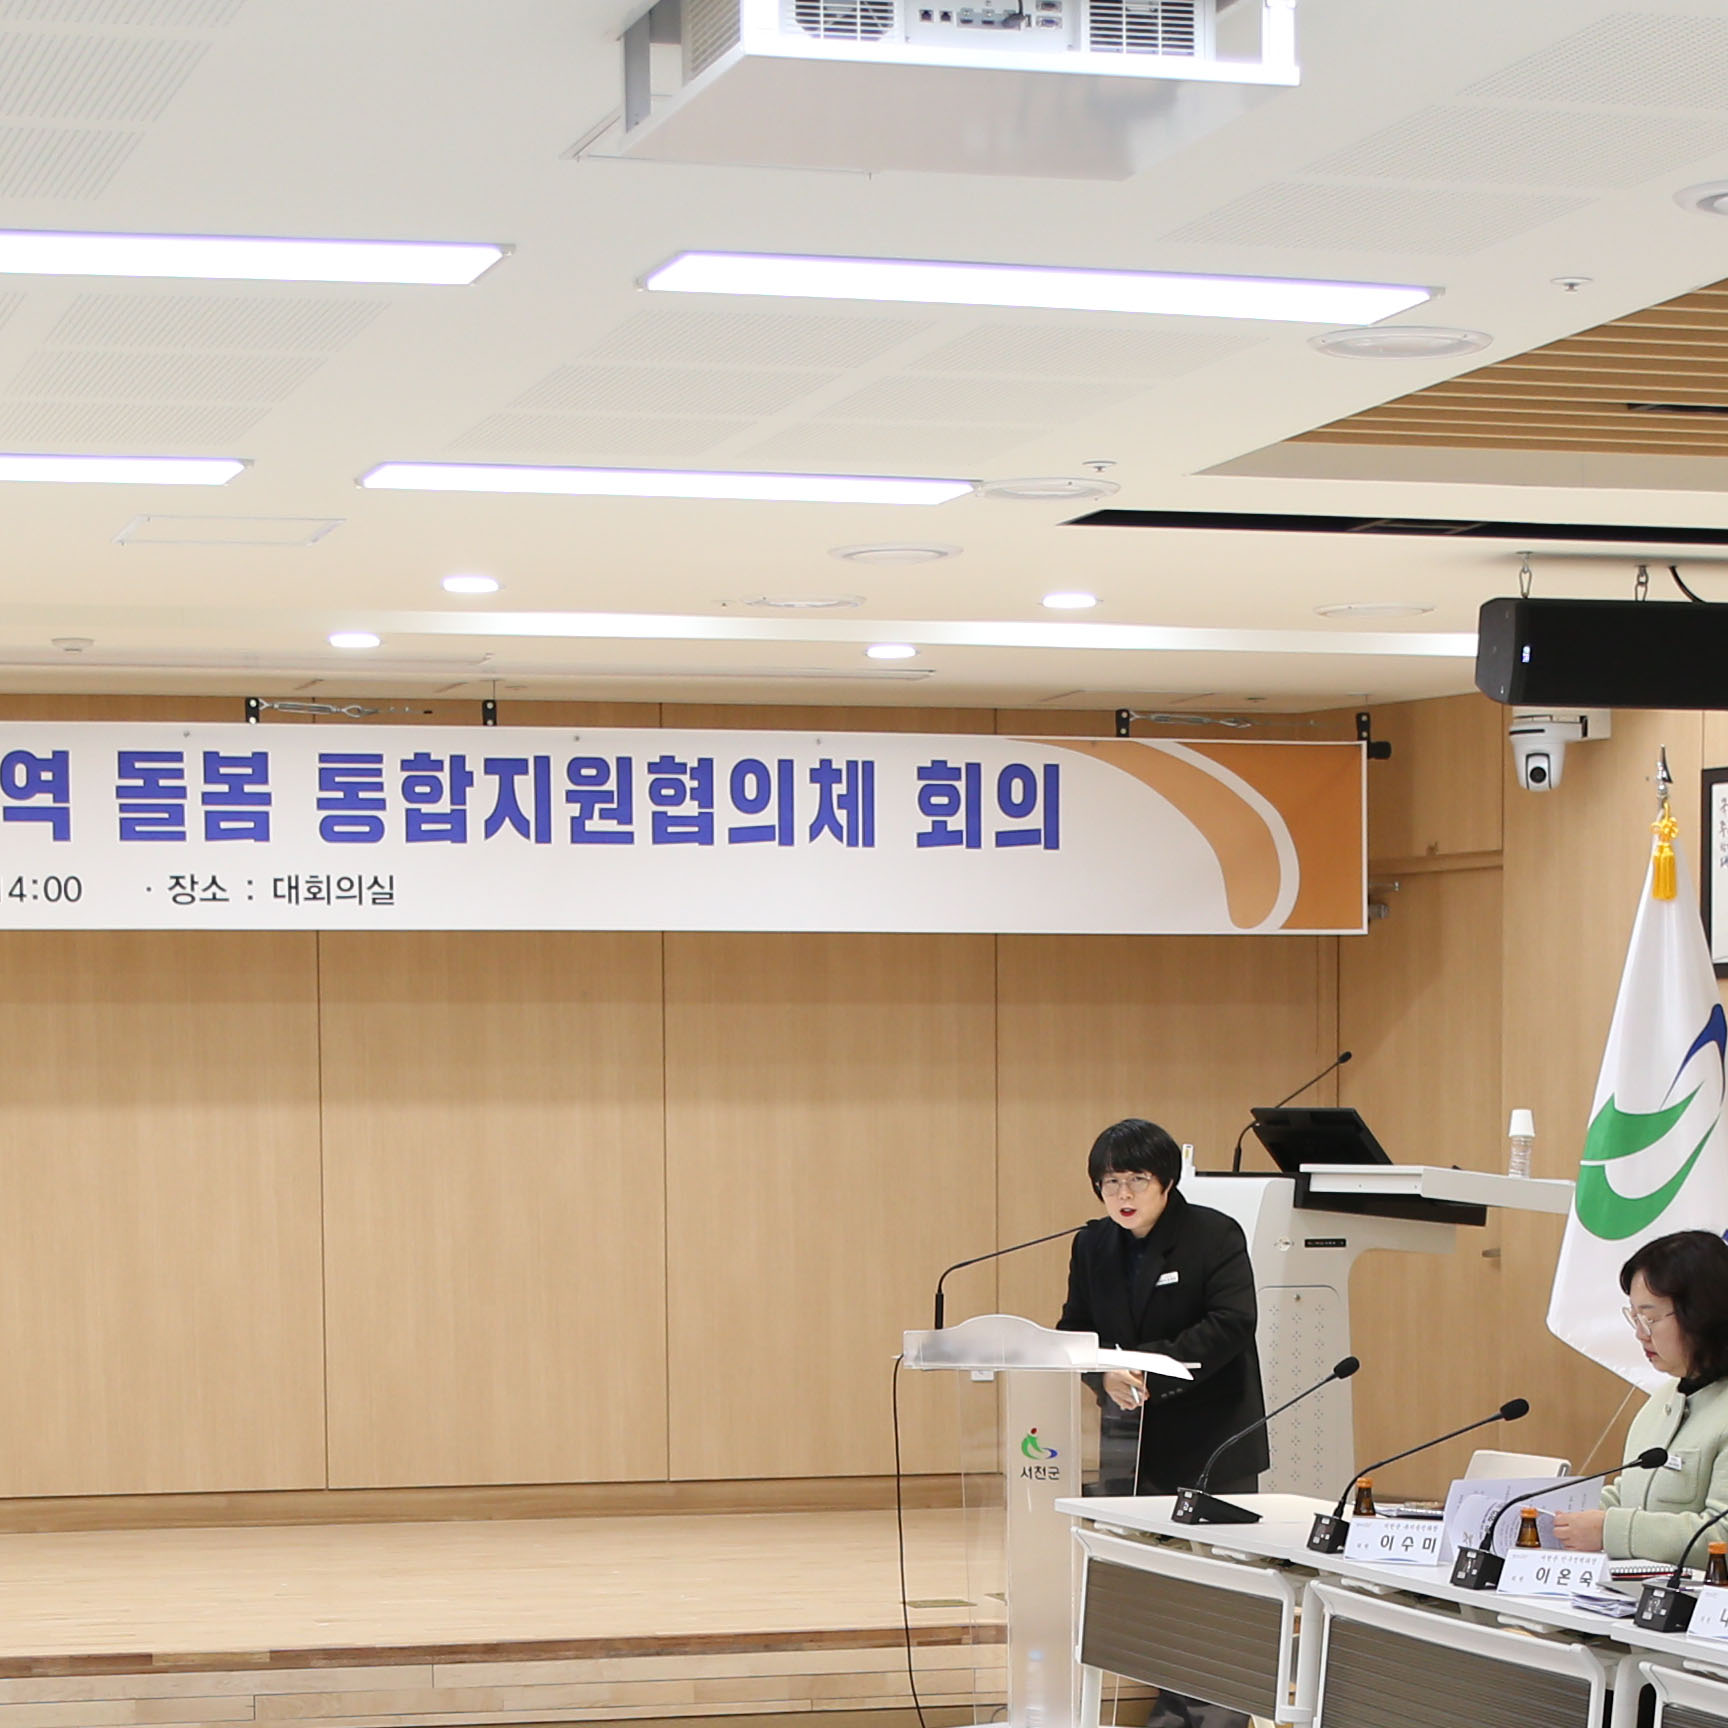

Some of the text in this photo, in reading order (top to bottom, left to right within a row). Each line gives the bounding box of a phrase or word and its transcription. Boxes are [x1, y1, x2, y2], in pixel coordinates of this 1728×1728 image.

[116, 751, 273, 843] 돌봄
[317, 752, 876, 848] 통합지원협의체
[917, 759, 1060, 851] 회의
[168, 874, 230, 905] 장소
[273, 874, 395, 906] 대회의실
[1020, 1465, 1060, 1481] 서천군
[1380, 1535, 1437, 1553] 이수미
[1536, 1567, 1593, 1588] 이온숙
